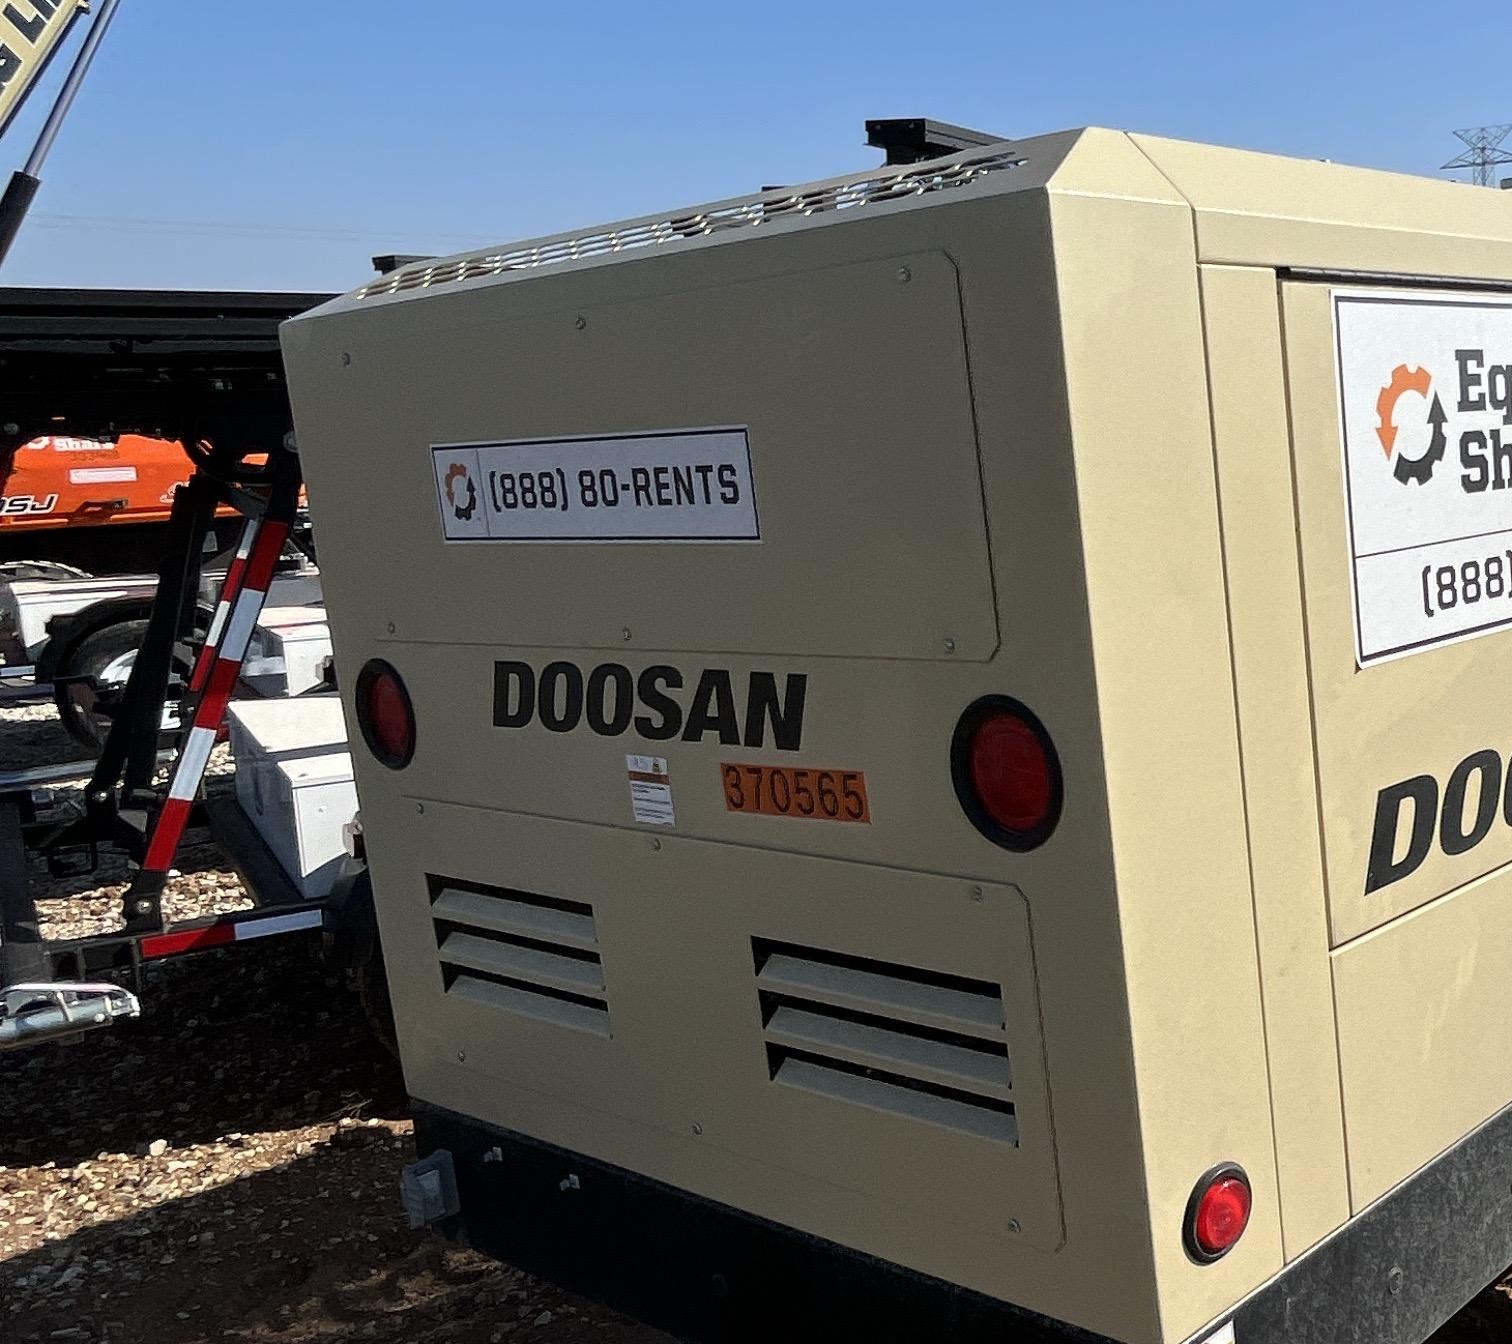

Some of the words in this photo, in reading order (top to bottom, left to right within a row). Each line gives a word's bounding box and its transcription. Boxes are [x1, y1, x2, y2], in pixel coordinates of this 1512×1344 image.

[490, 467, 568, 512] (888)
[579, 463, 740, 508] 80-RENTS
[492, 660, 808, 752] DOOSAN
[723, 764, 867, 820] 370565
